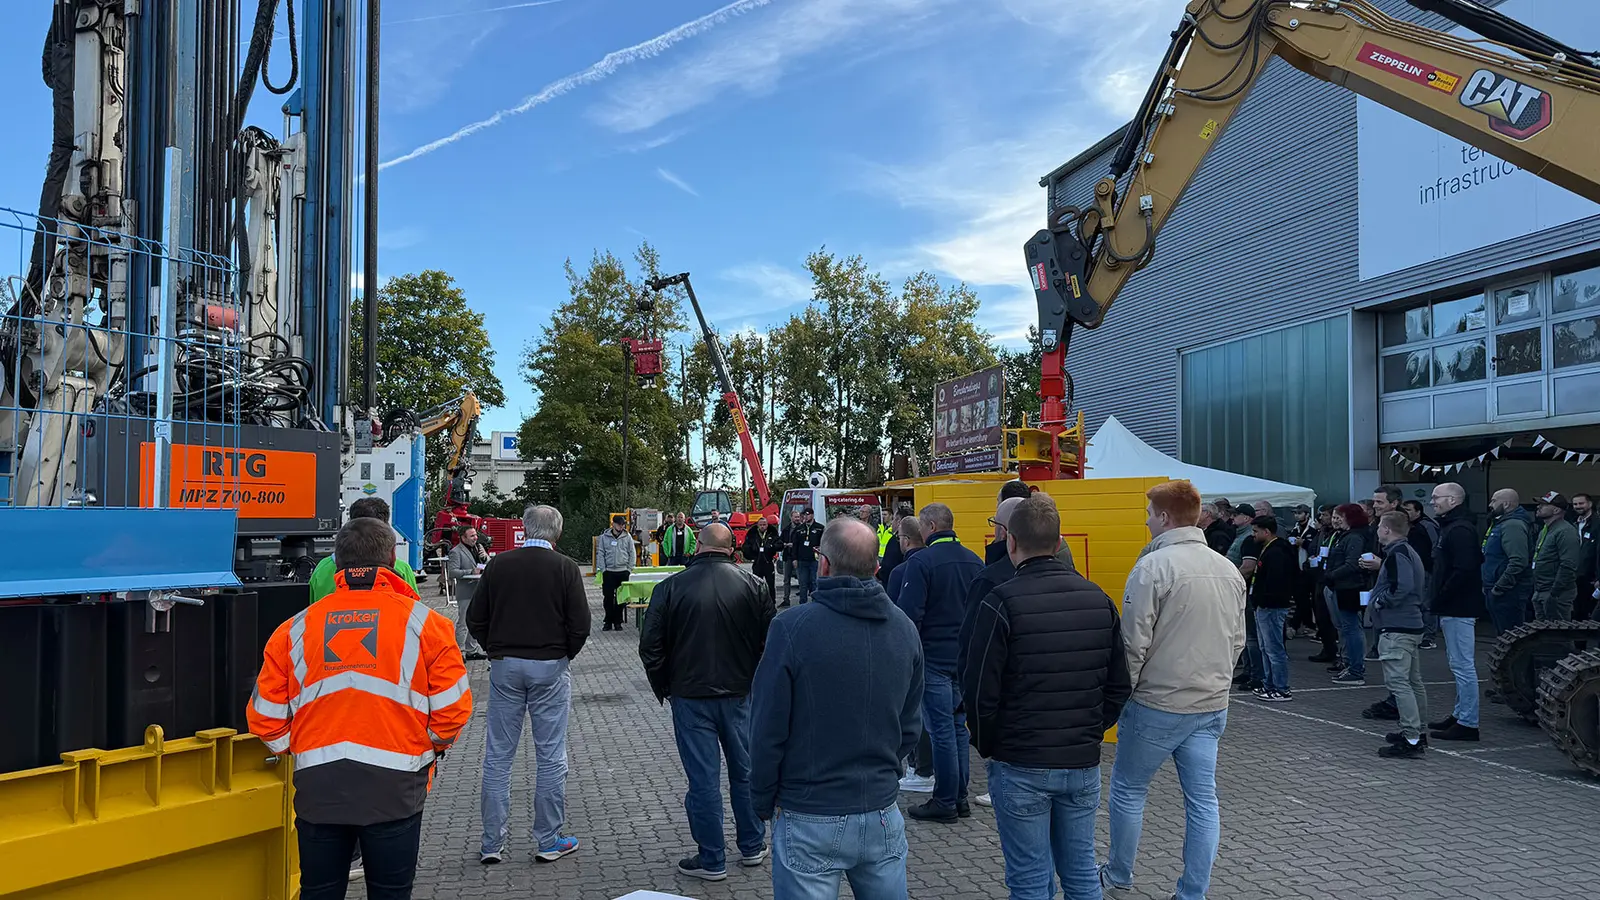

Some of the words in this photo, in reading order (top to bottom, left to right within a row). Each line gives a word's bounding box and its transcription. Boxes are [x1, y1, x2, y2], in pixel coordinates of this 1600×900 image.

[1369, 51, 1423, 77] ZEPPELIN
[1460, 69, 1542, 125] CAT
[1420, 160, 1522, 205] infrastruc
[202, 450, 267, 478] RTG
[179, 489, 218, 503] MPZ
[222, 490, 286, 504] 700-800
[327, 610, 378, 625] kroker
